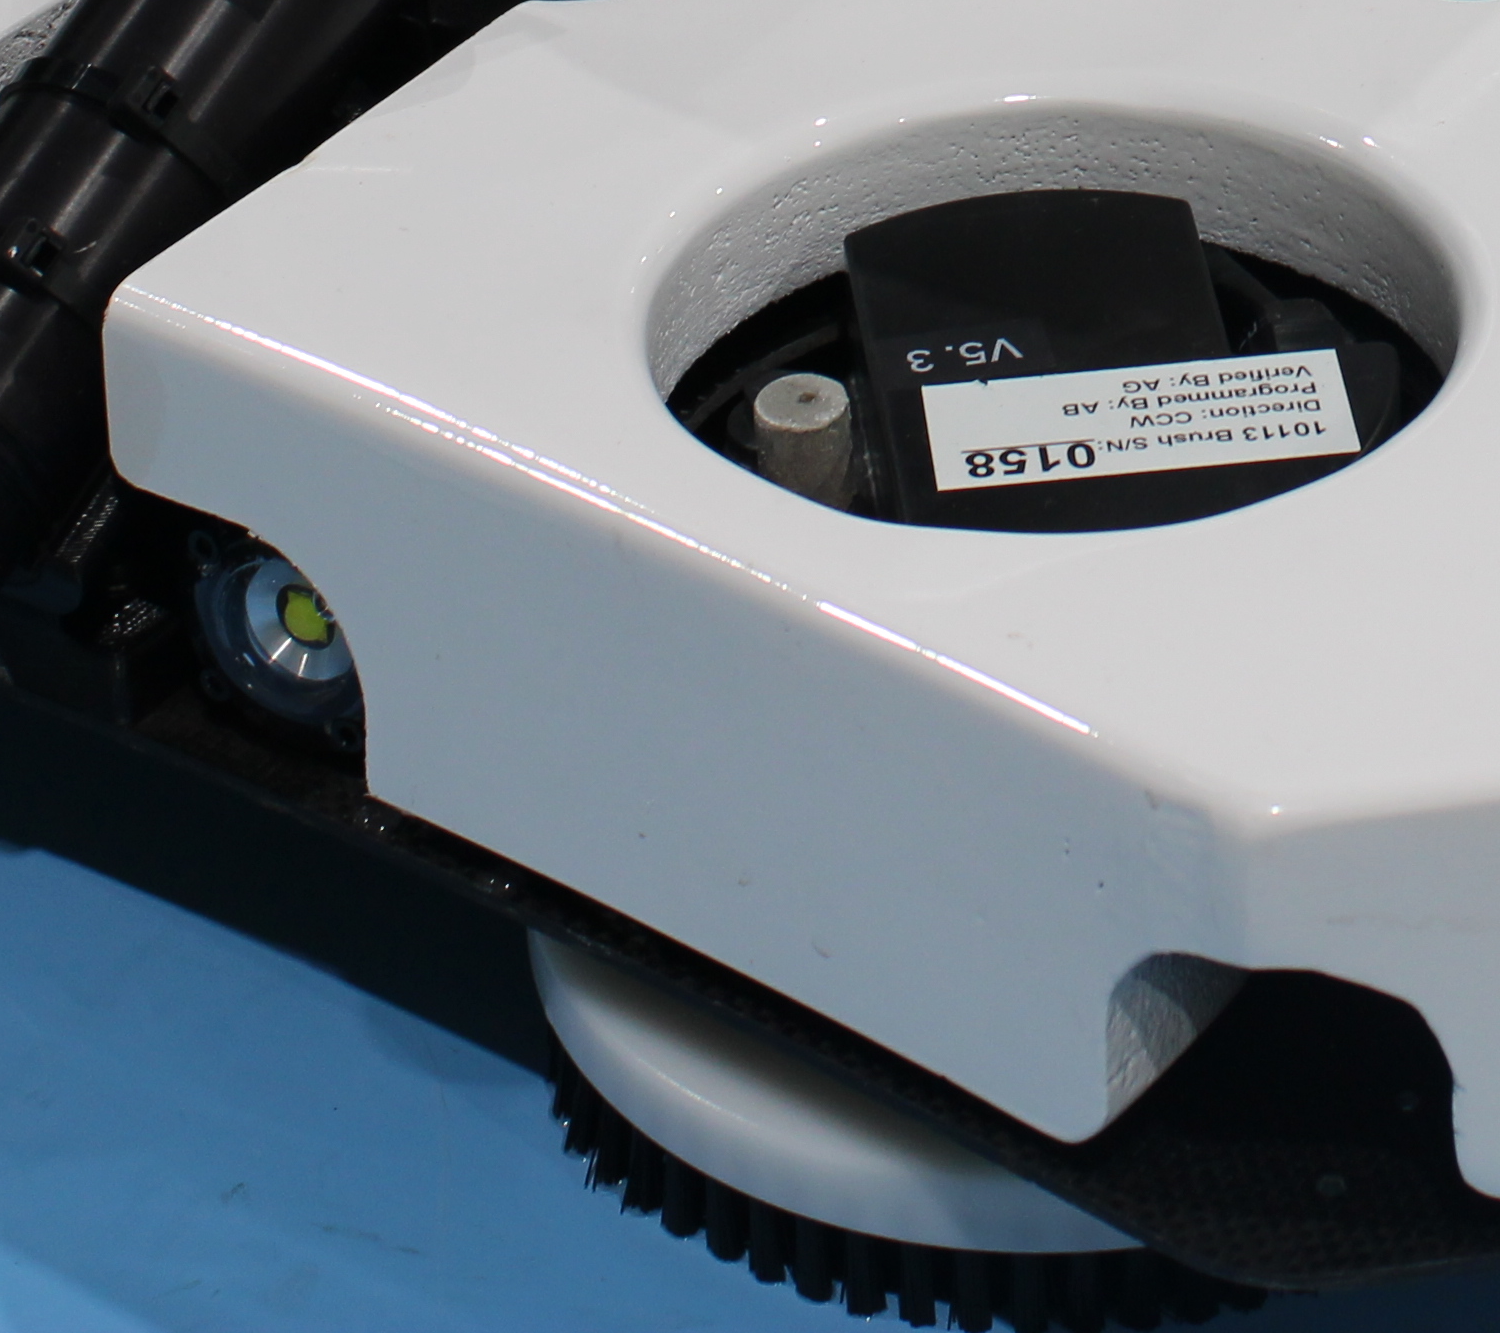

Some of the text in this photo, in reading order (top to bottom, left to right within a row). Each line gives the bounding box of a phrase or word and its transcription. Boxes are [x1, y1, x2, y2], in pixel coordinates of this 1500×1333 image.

[1122, 364, 1313, 394] Verified By: AG
[1061, 381, 1318, 416] Programmed By: AB
[1129, 398, 1322, 429] Direction: CCW
[964, 419, 1328, 478] 10113 Brush S/N: 0158
